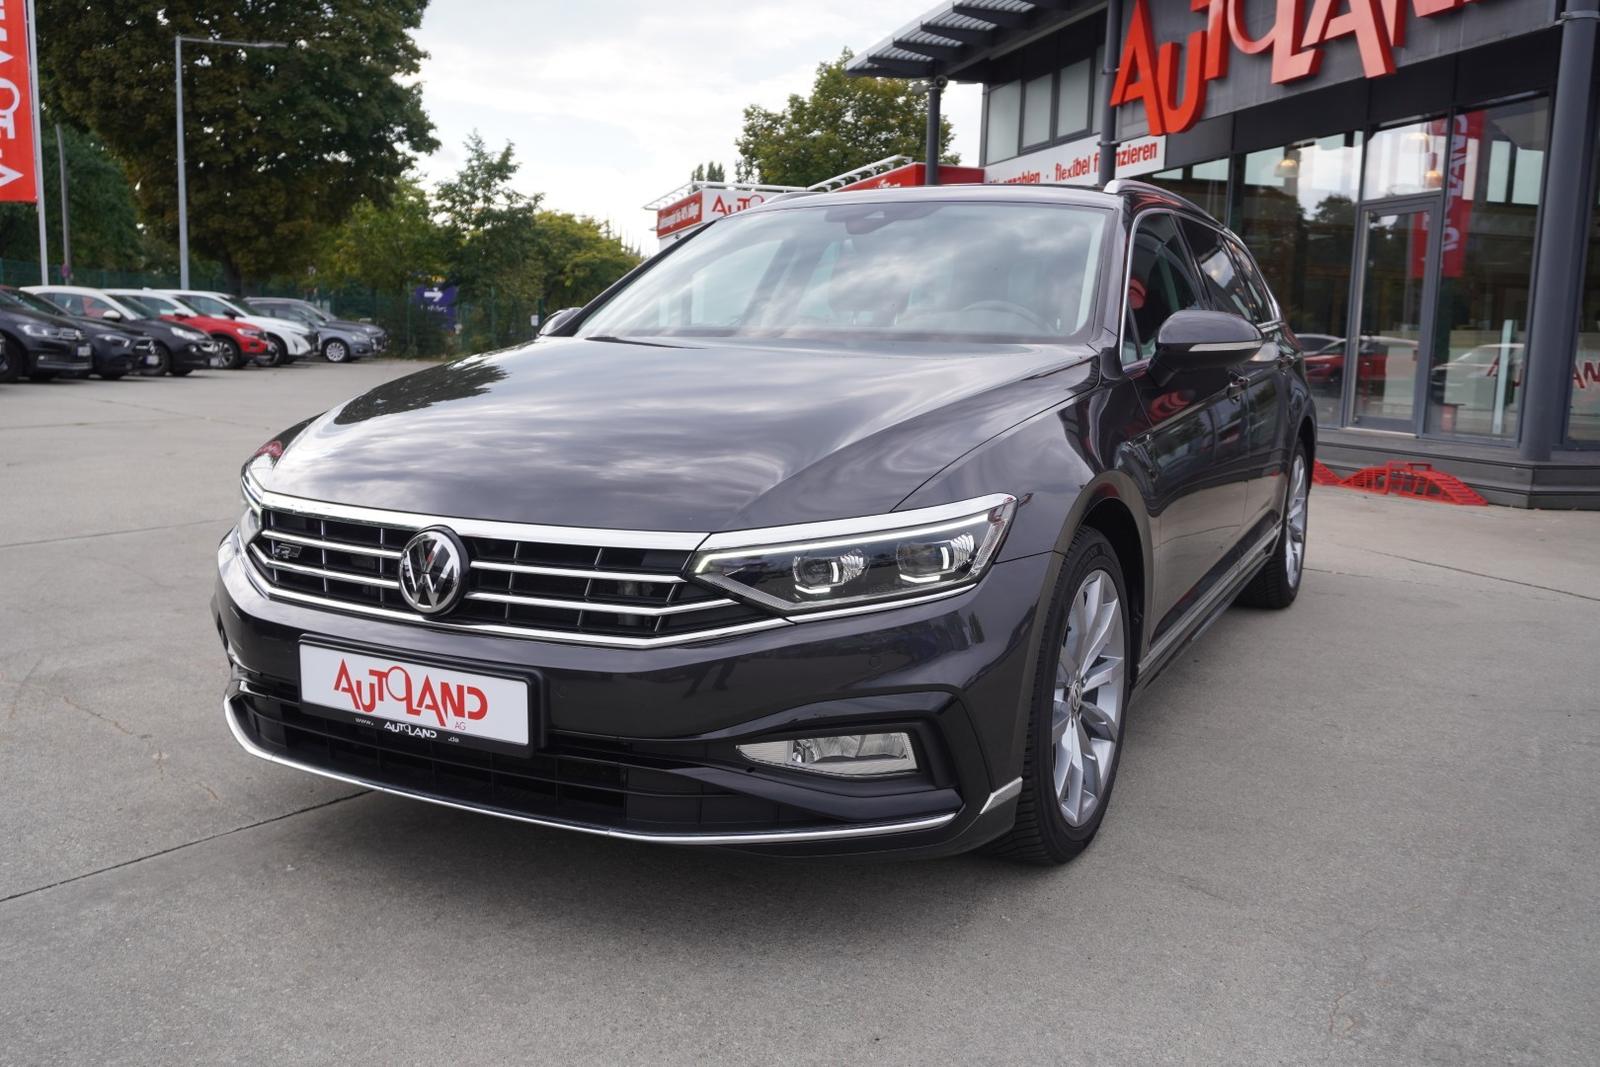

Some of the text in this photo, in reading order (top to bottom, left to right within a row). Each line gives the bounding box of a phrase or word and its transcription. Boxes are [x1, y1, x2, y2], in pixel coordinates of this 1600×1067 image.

[1110, 0, 1482, 136] AUTOLA
[1055, 155, 1090, 182] flexibel
[1093, 142, 1157, 173] fnzieren
[334, 658, 489, 727] AUTOLAND
[384, 721, 438, 739] AUTOLAND
[454, 721, 467, 732] AG
